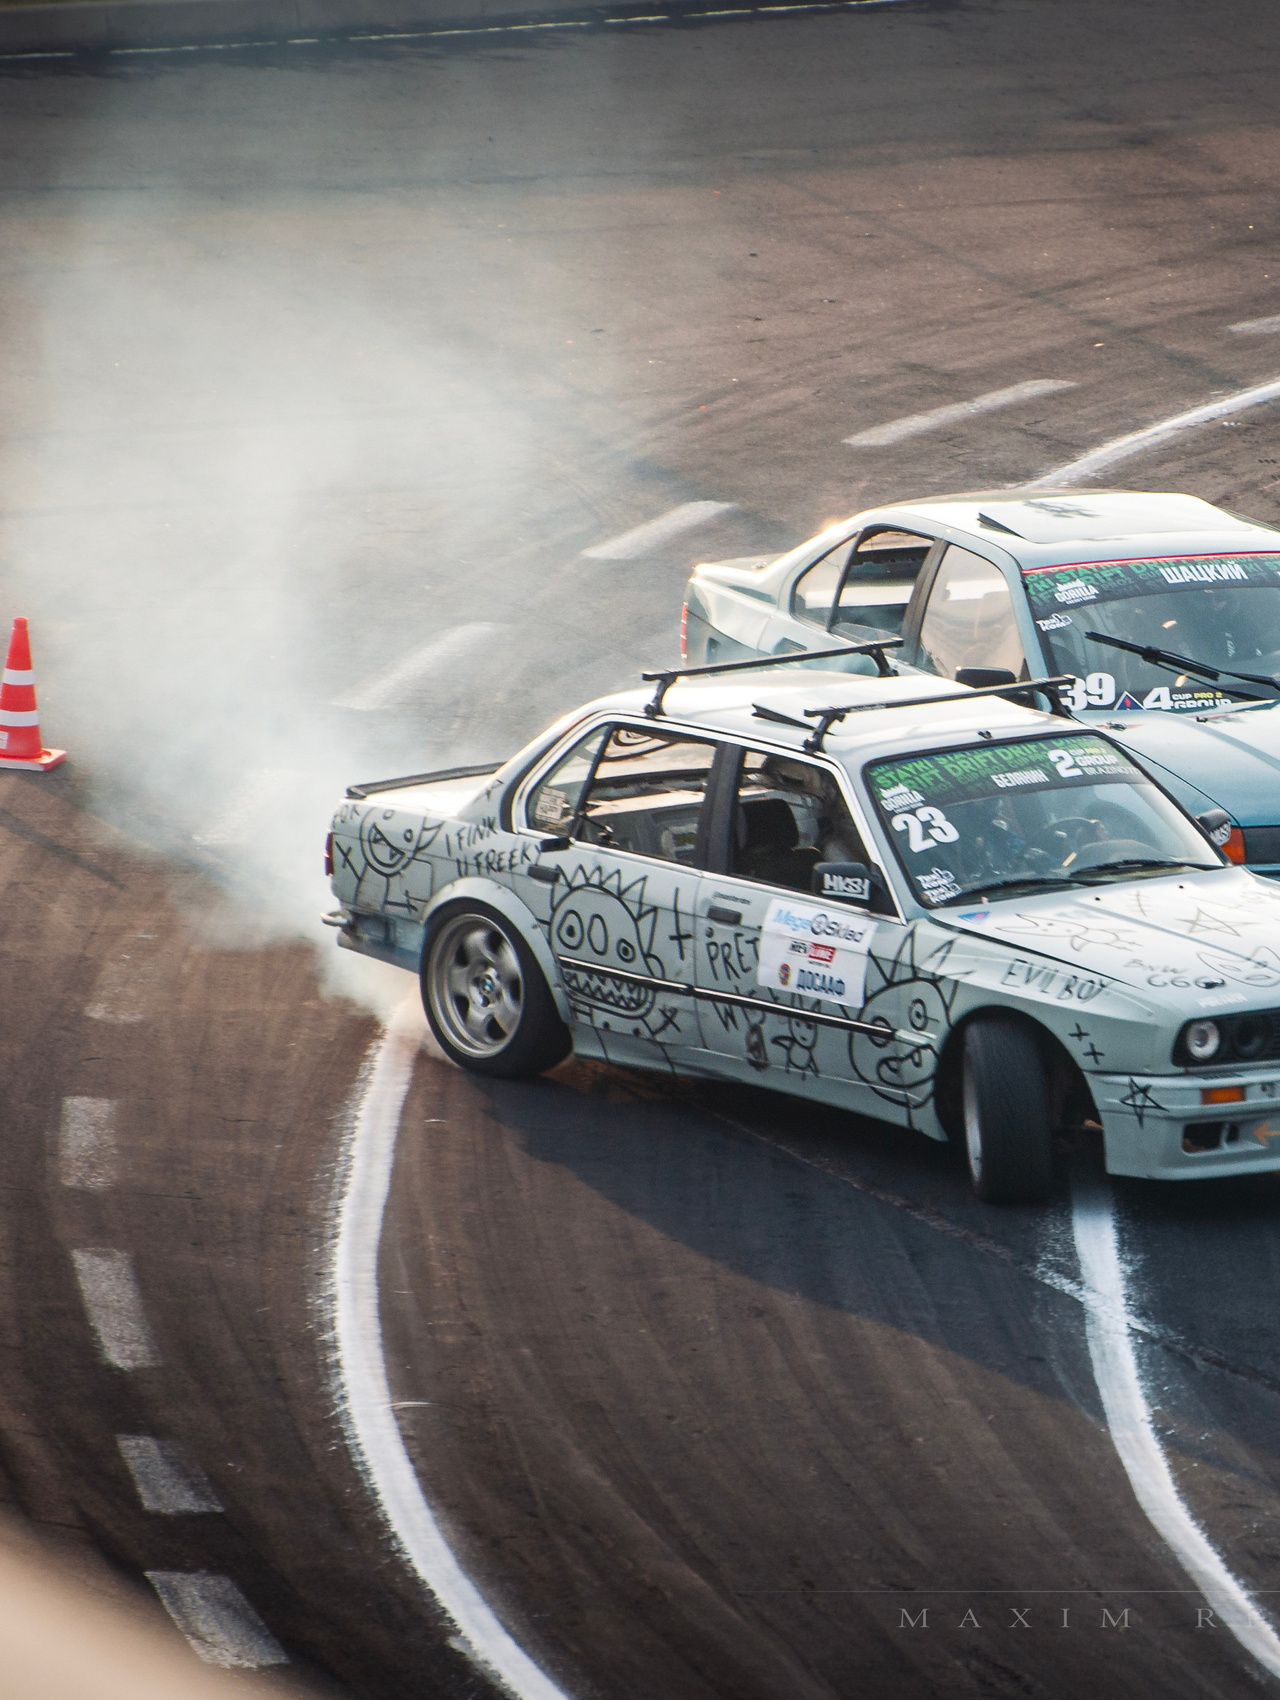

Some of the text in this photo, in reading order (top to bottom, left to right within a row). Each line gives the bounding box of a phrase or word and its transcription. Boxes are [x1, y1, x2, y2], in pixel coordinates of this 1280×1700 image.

[1159, 561, 1249, 584] ШАЦКИЙ
[1054, 584, 1100, 603] GORILLA
[1058, 673, 1116, 712] 39
[1143, 687, 1174, 710] 4
[943, 750, 1001, 780] DRIFT
[1047, 749, 1083, 778] 2
[1074, 755, 1119, 767] GROUP
[880, 789, 926, 812] GORILLA
[455, 815, 498, 851] FINK
[891, 806, 960, 853] 23
